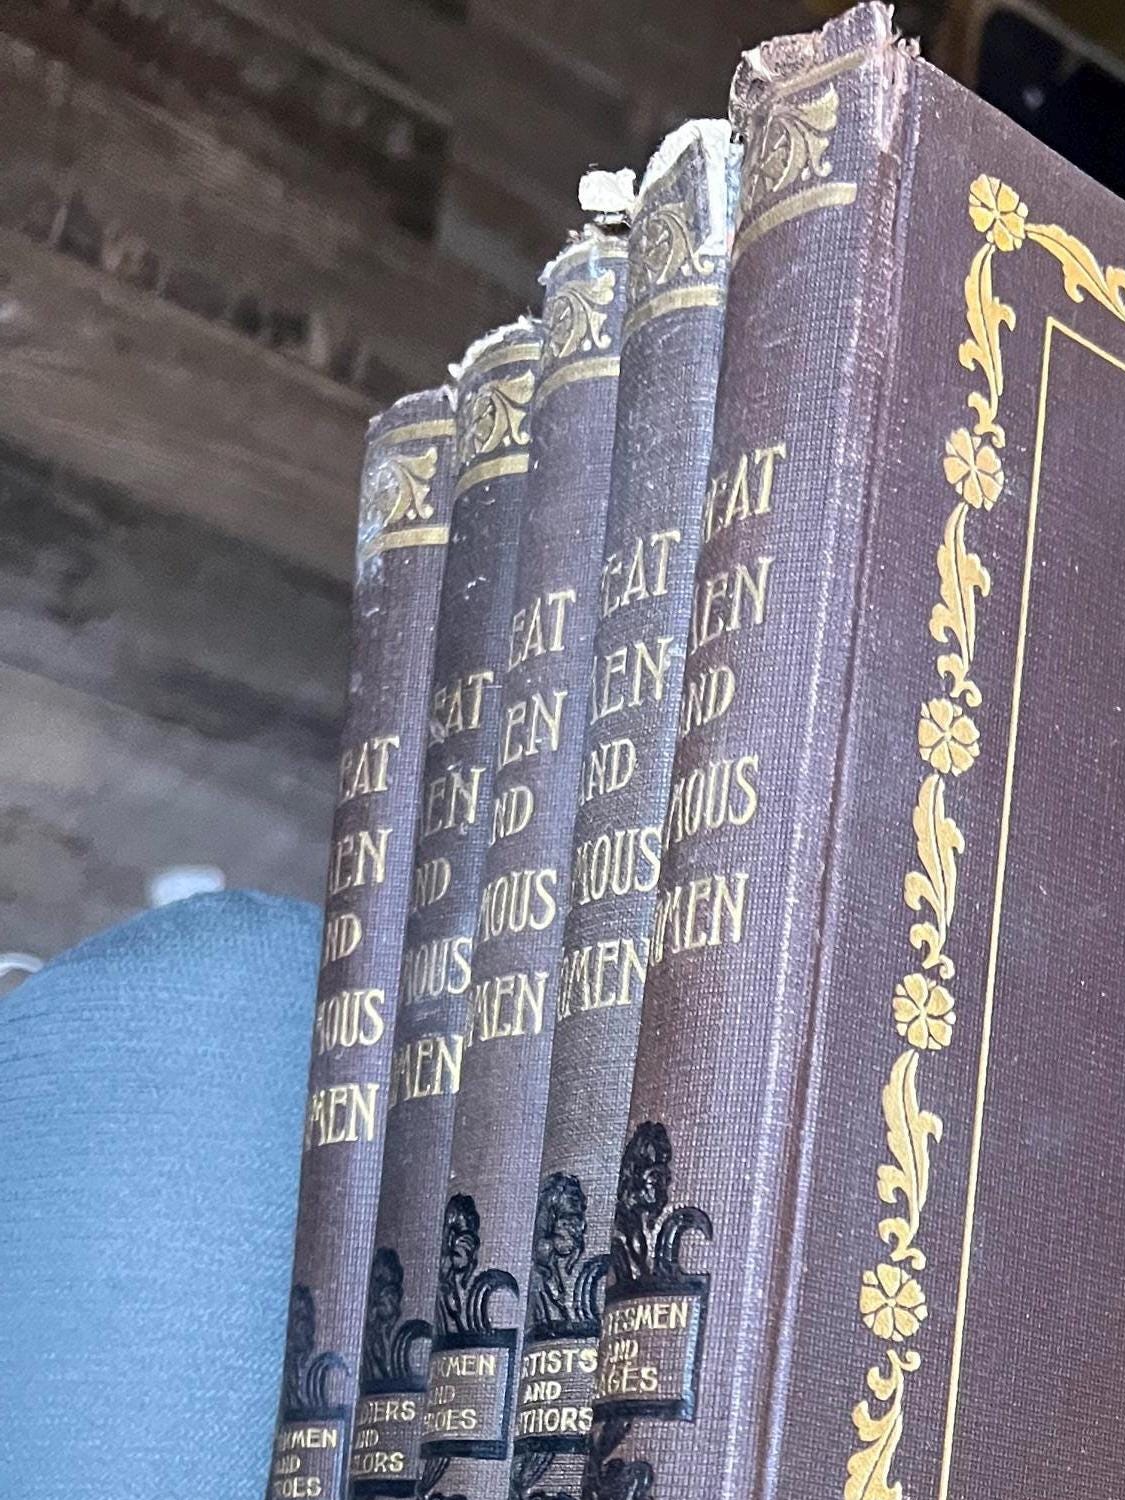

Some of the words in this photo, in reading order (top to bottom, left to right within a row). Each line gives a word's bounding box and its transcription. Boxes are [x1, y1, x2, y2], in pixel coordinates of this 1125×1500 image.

[703, 444, 786, 544] EAT
[602, 530, 681, 617] EAT
[507, 589, 576, 673] EAT
[428, 671, 495, 748] EAT
[500, 691, 568, 770] EN
[338, 735, 400, 803] EAT
[423, 767, 487, 837] EN
[331, 828, 393, 895] EN
[522, 1381, 562, 1405] AND
